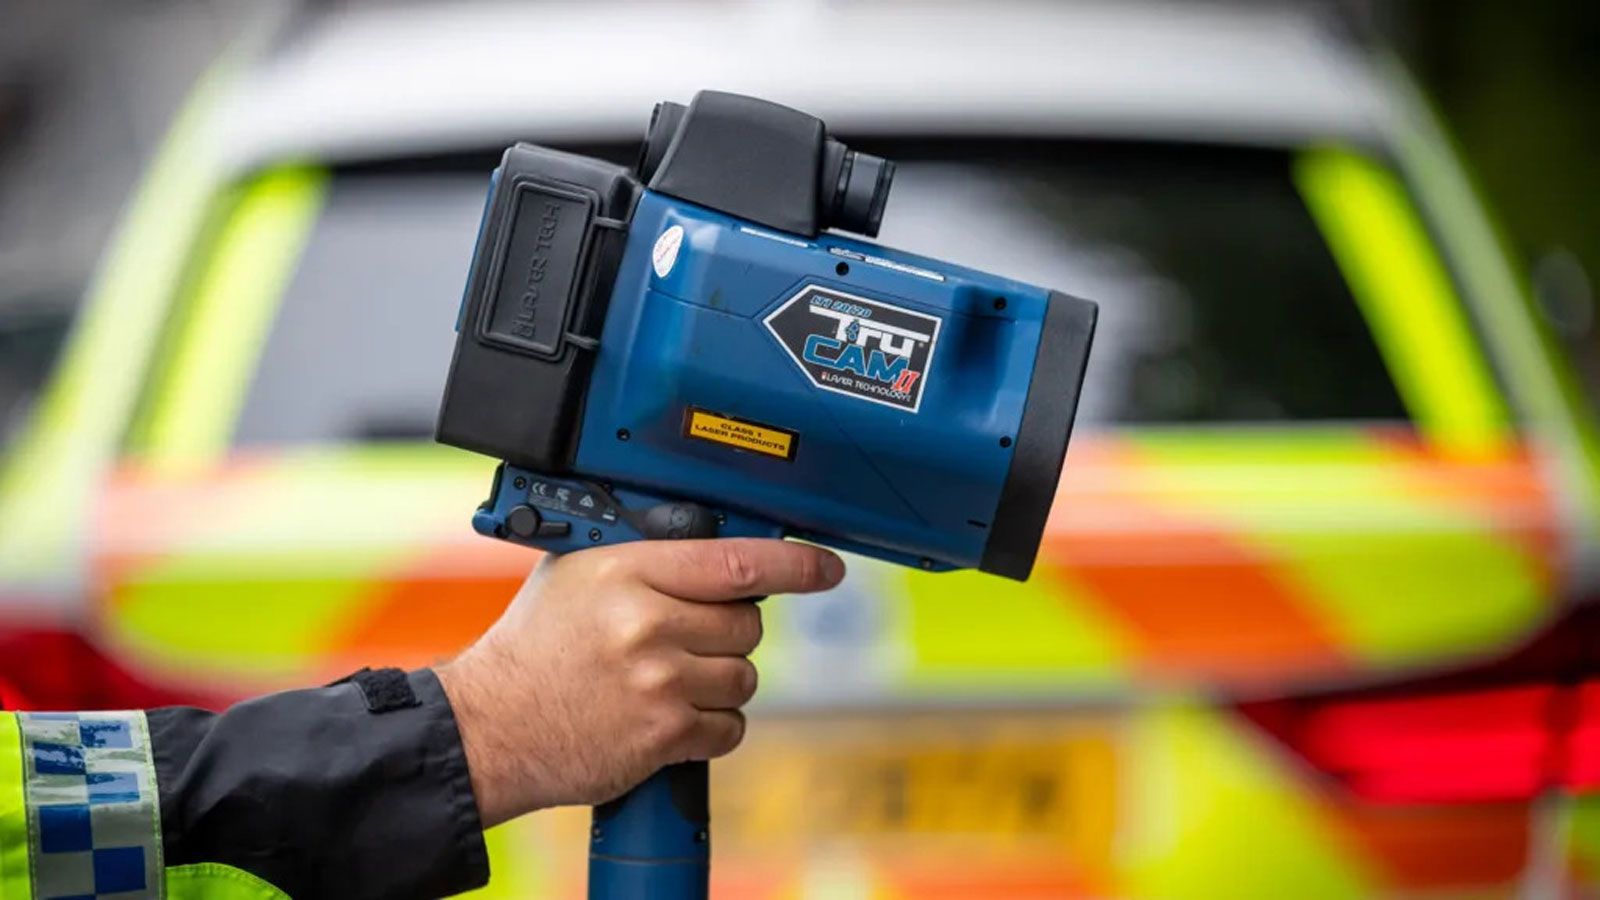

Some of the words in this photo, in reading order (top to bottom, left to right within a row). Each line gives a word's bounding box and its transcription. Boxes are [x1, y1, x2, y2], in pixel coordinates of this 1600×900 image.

[695, 424, 729, 437] LASER
[730, 433, 786, 451] PRODUCTS
[720, 423, 754, 437] CLASS
